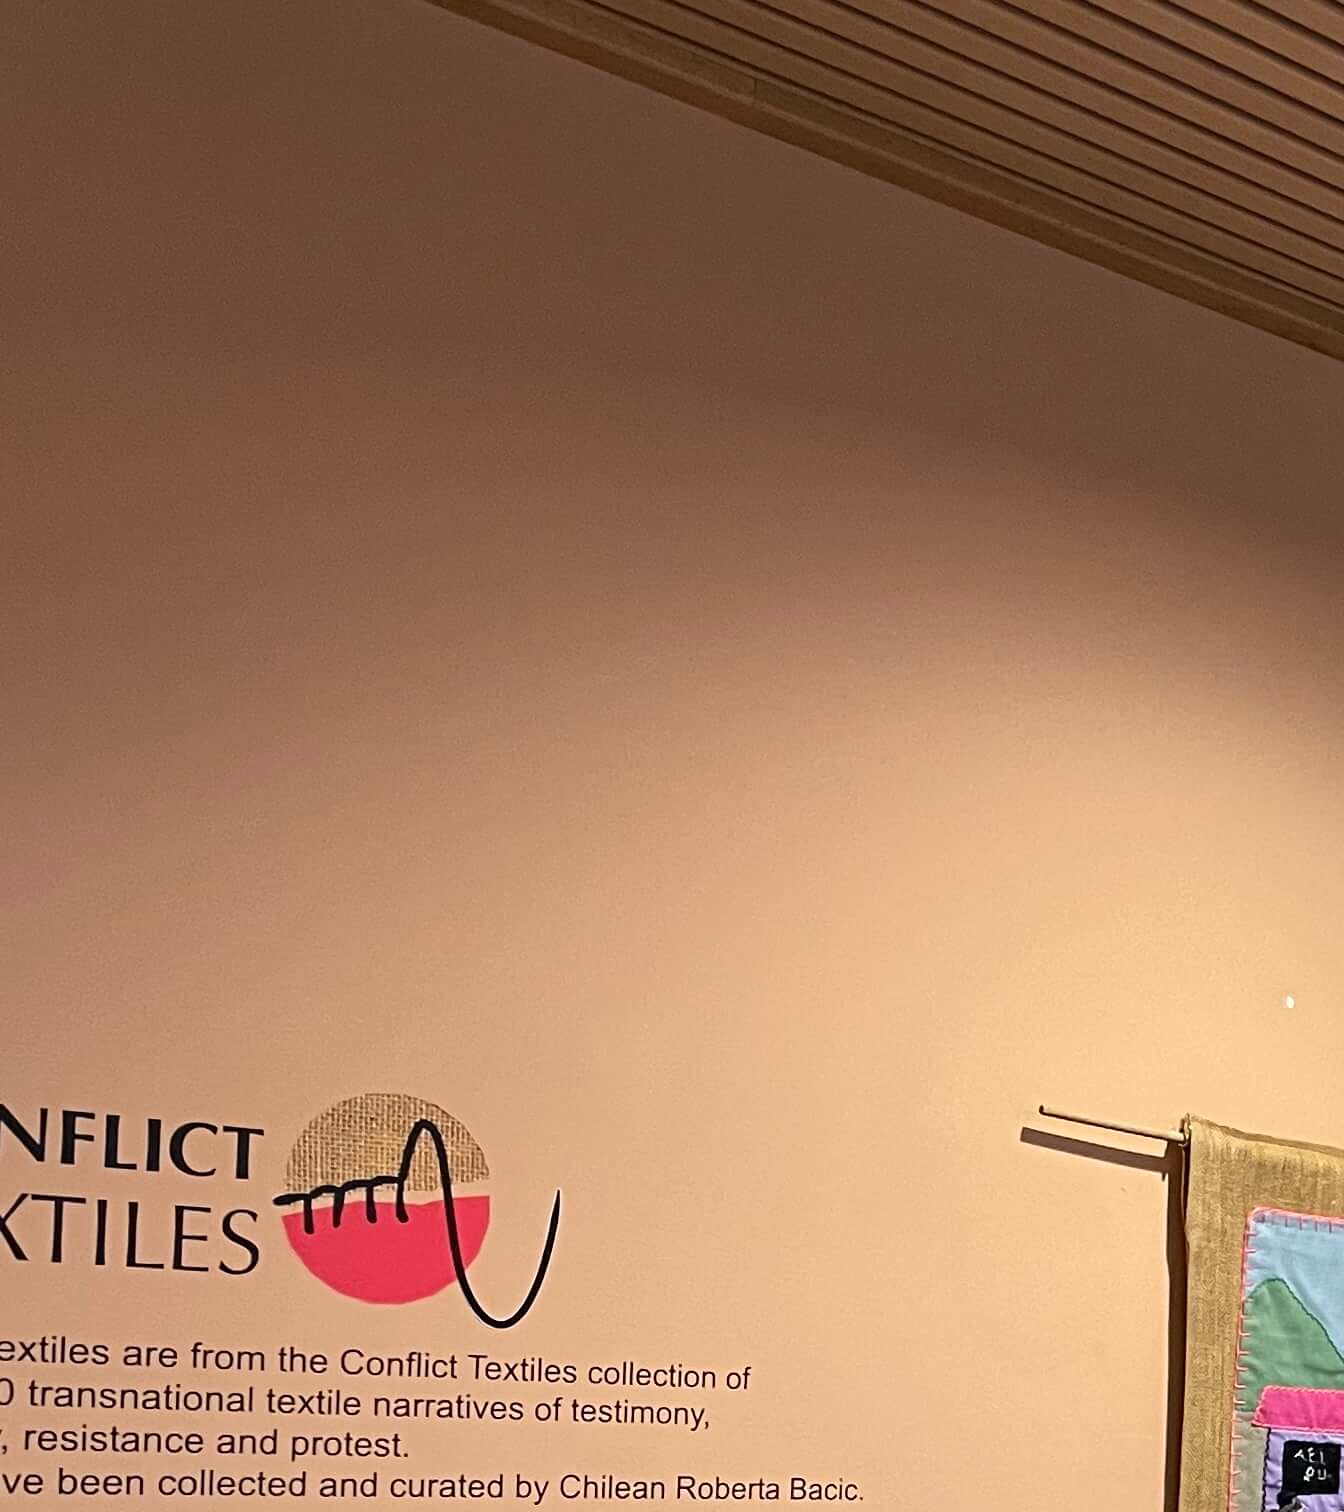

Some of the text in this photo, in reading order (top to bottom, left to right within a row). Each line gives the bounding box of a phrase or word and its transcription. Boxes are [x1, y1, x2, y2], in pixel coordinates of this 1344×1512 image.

[0, 1336, 752, 1389] extiles are from the Conflict Textiles collection of
[29, 1380, 253, 1412] transnational
[267, 1389, 361, 1416] textile
[374, 1395, 524, 1421] narratives
[535, 1397, 563, 1421] of
[571, 1399, 710, 1431] testimony,
[24, 1424, 204, 1454] resistance
[217, 1429, 278, 1455] and
[291, 1432, 409, 1462] protest.
[58, 1468, 144, 1496] been
[158, 1469, 307, 1497] collected
[319, 1472, 378, 1498] and
[390, 1474, 504, 1499] curated
[516, 1474, 550, 1505] by
[560, 1474, 665, 1500] Chilean
[677, 1476, 780, 1501] Roberta
[790, 1478, 864, 1502] Bacic.
